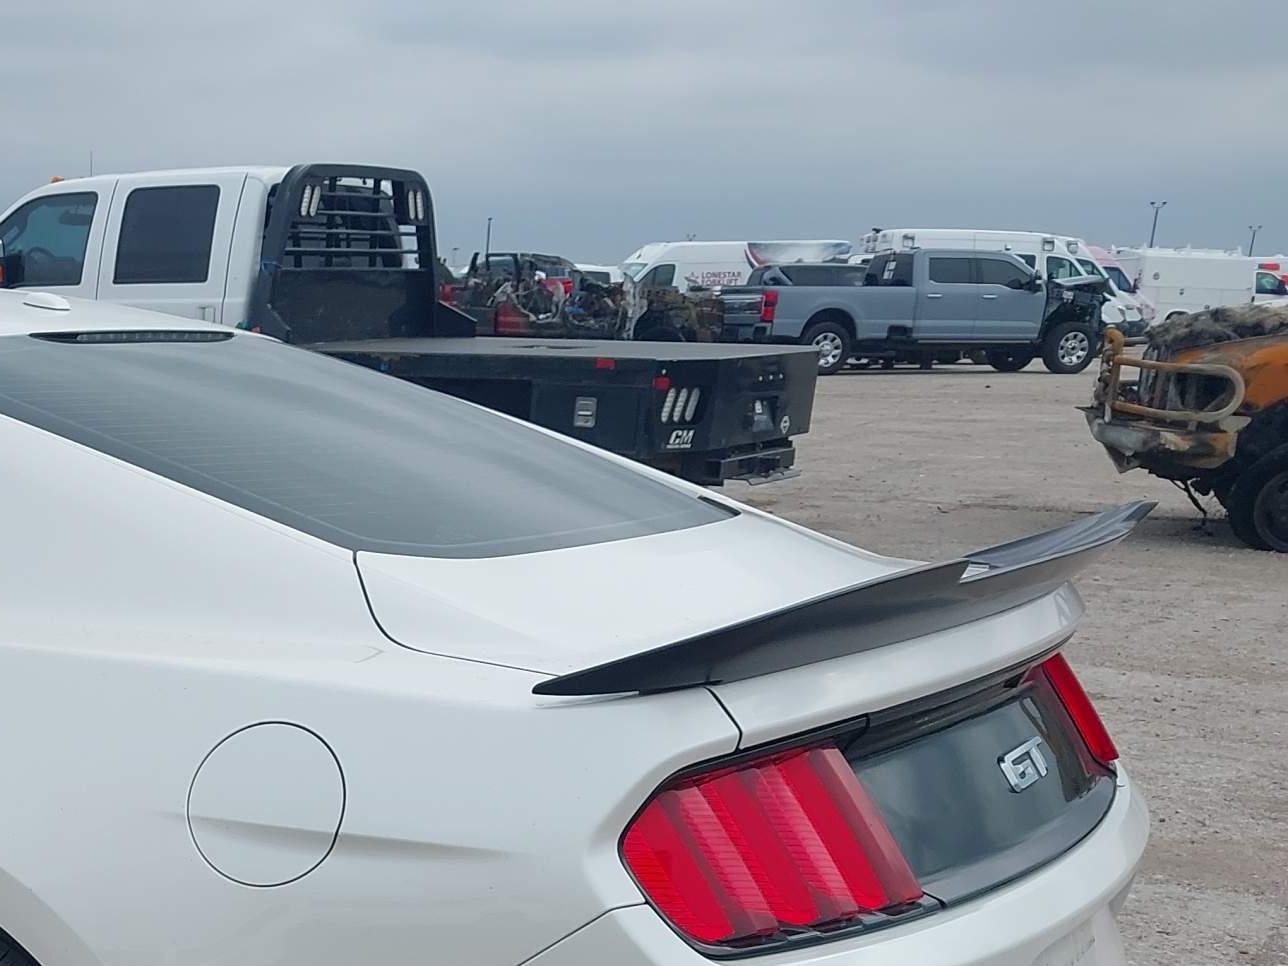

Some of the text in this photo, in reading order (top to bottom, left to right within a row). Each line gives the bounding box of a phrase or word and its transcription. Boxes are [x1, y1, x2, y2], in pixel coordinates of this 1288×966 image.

[701, 271, 742, 279] LONESTAR
[669, 429, 695, 445] CM
[999, 735, 1049, 793] GT
